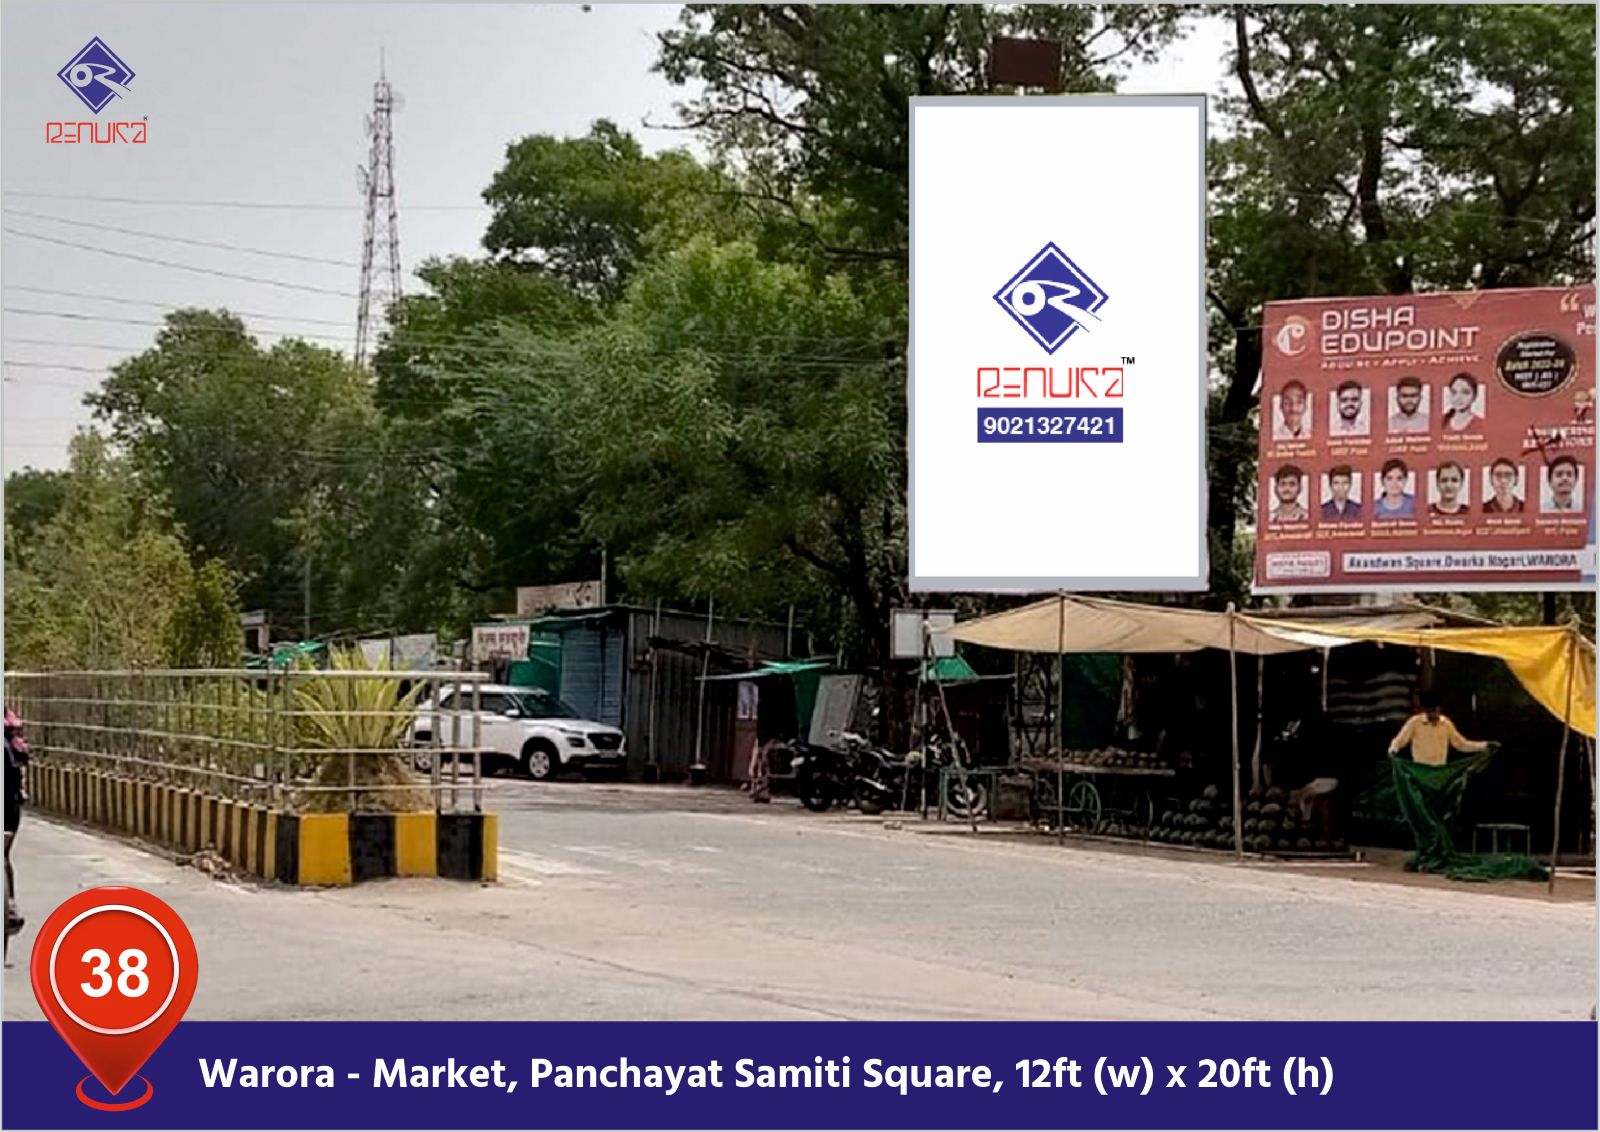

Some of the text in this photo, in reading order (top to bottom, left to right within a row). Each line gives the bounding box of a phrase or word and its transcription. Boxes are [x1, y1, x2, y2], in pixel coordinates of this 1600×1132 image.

[1321, 305, 1415, 331] DISHA
[1321, 326, 1480, 355] EDUPOINT
[1121, 356, 1135, 365] TM
[983, 416, 1115, 435] 9021327421
